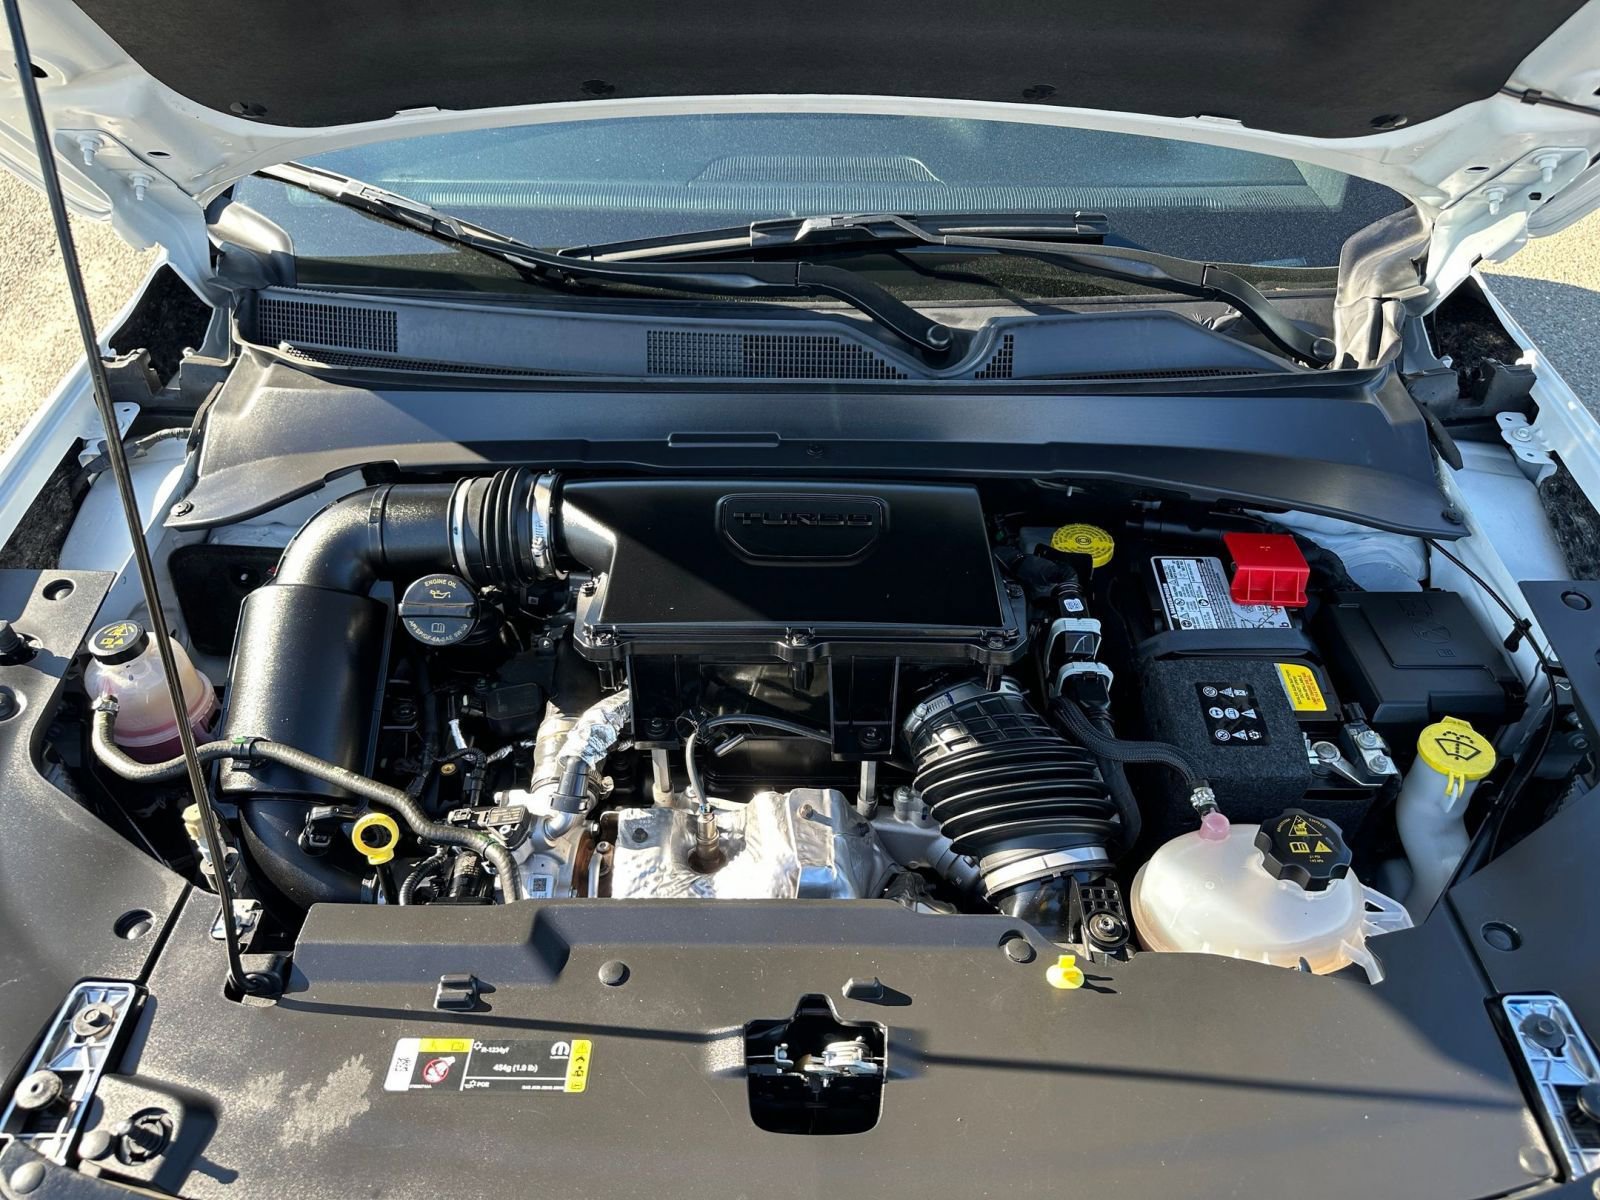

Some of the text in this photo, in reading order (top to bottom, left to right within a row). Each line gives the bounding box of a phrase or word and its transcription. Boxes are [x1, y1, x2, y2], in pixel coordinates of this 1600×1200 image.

[733, 511, 873, 527] TURBO
[424, 578, 457, 589] ENGINE OIL
[493, 1063, 512, 1073] 454g
